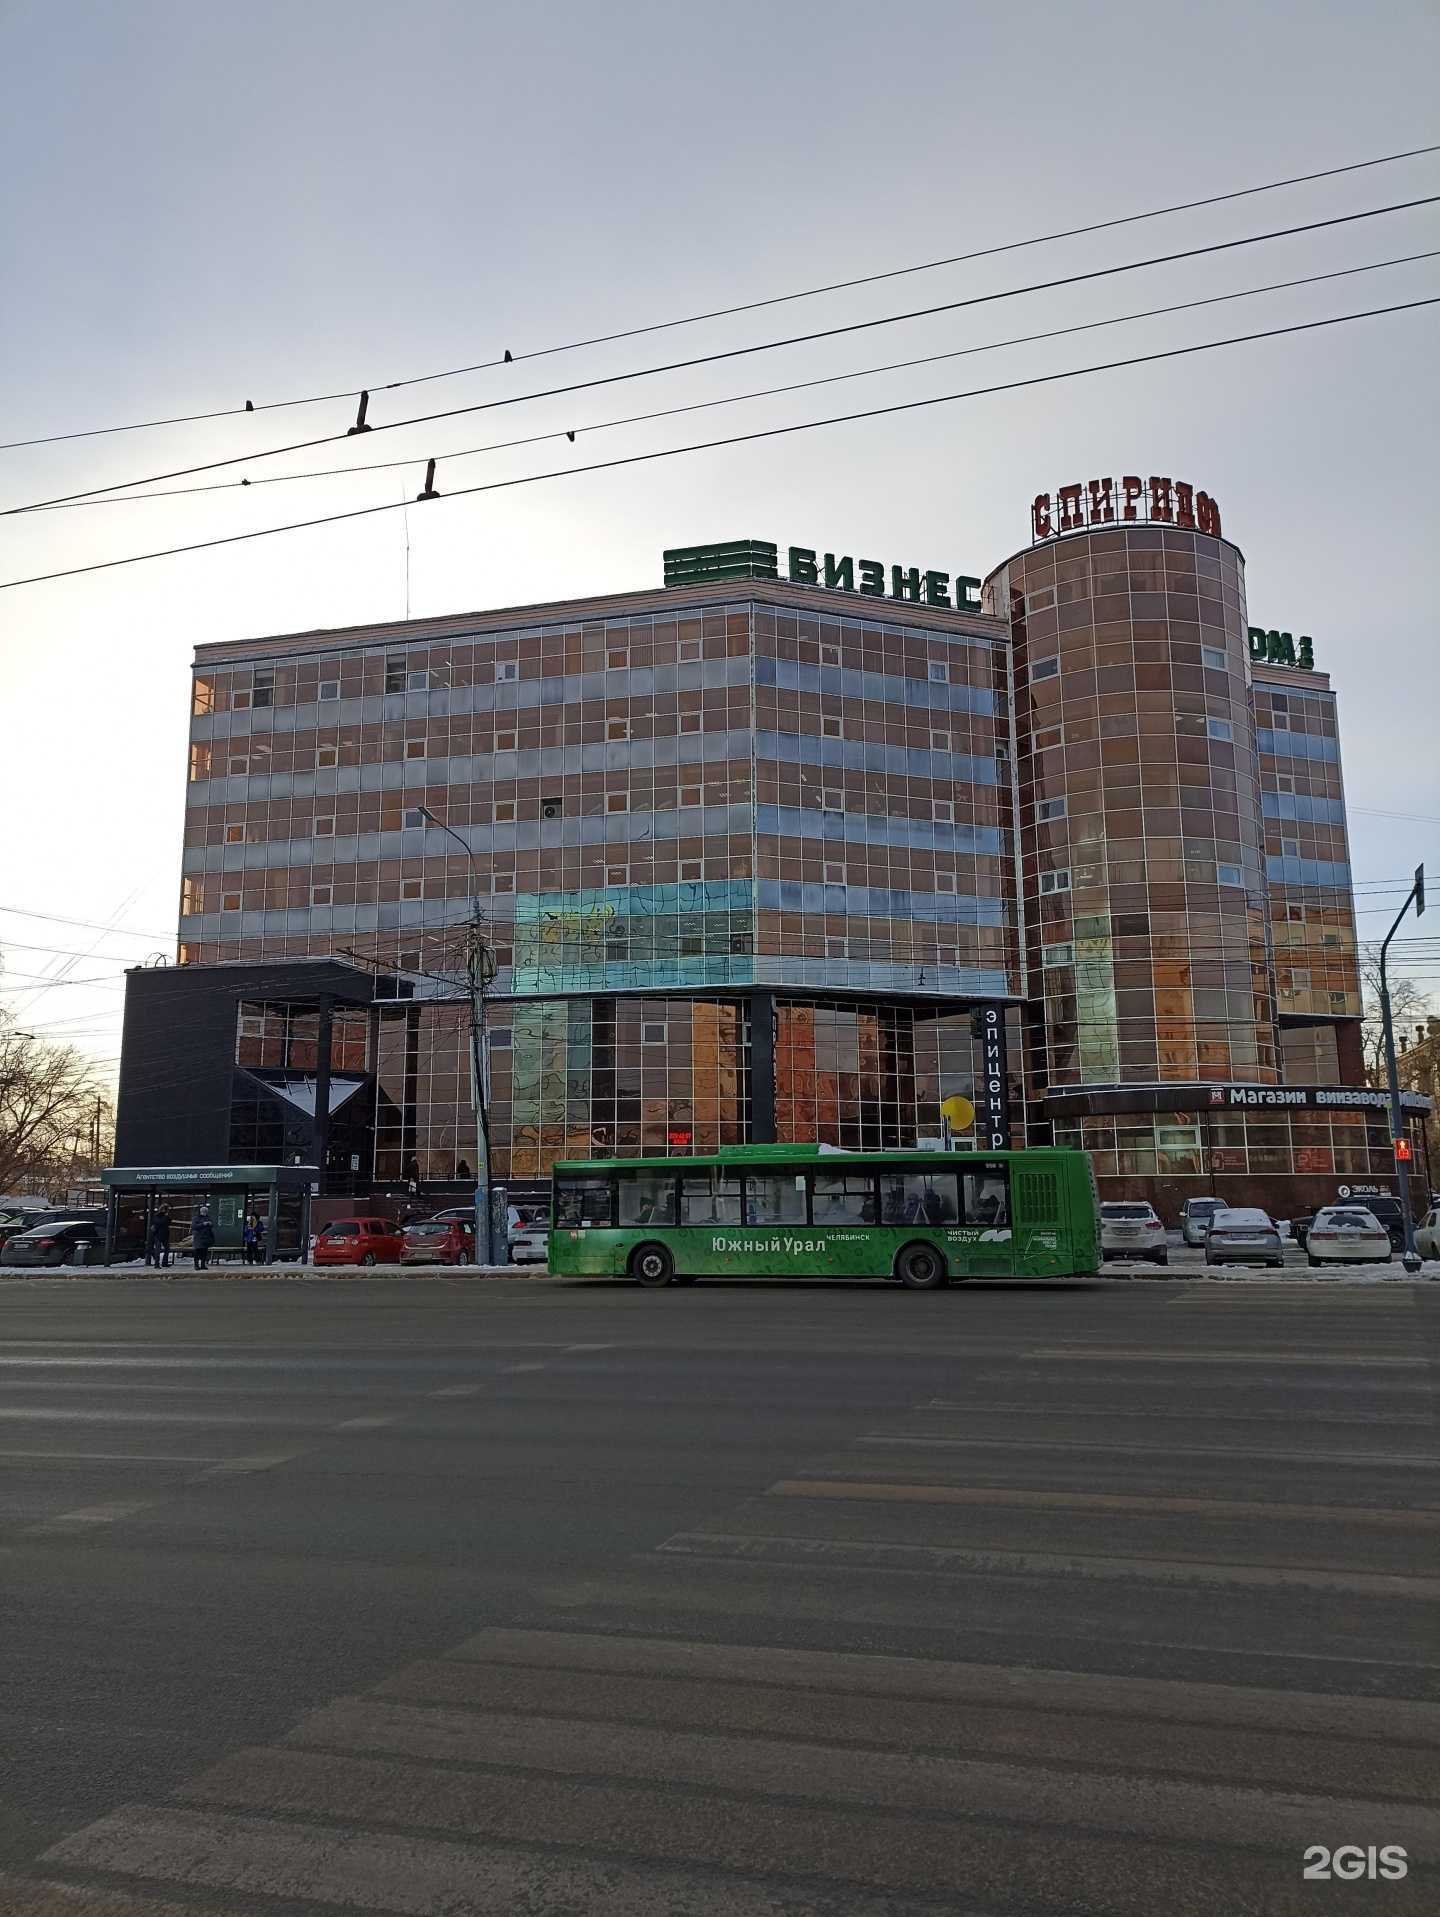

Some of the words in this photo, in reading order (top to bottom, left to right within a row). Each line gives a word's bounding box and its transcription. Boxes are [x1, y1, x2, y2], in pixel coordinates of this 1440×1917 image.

[789, 546, 982, 614] БИЗНЕС
[1248, 627, 1296, 666] ОМ
[1230, 1088, 1307, 1104] Магазин
[712, 1236, 781, 1252] Южный
[783, 1236, 826, 1255] Урал
